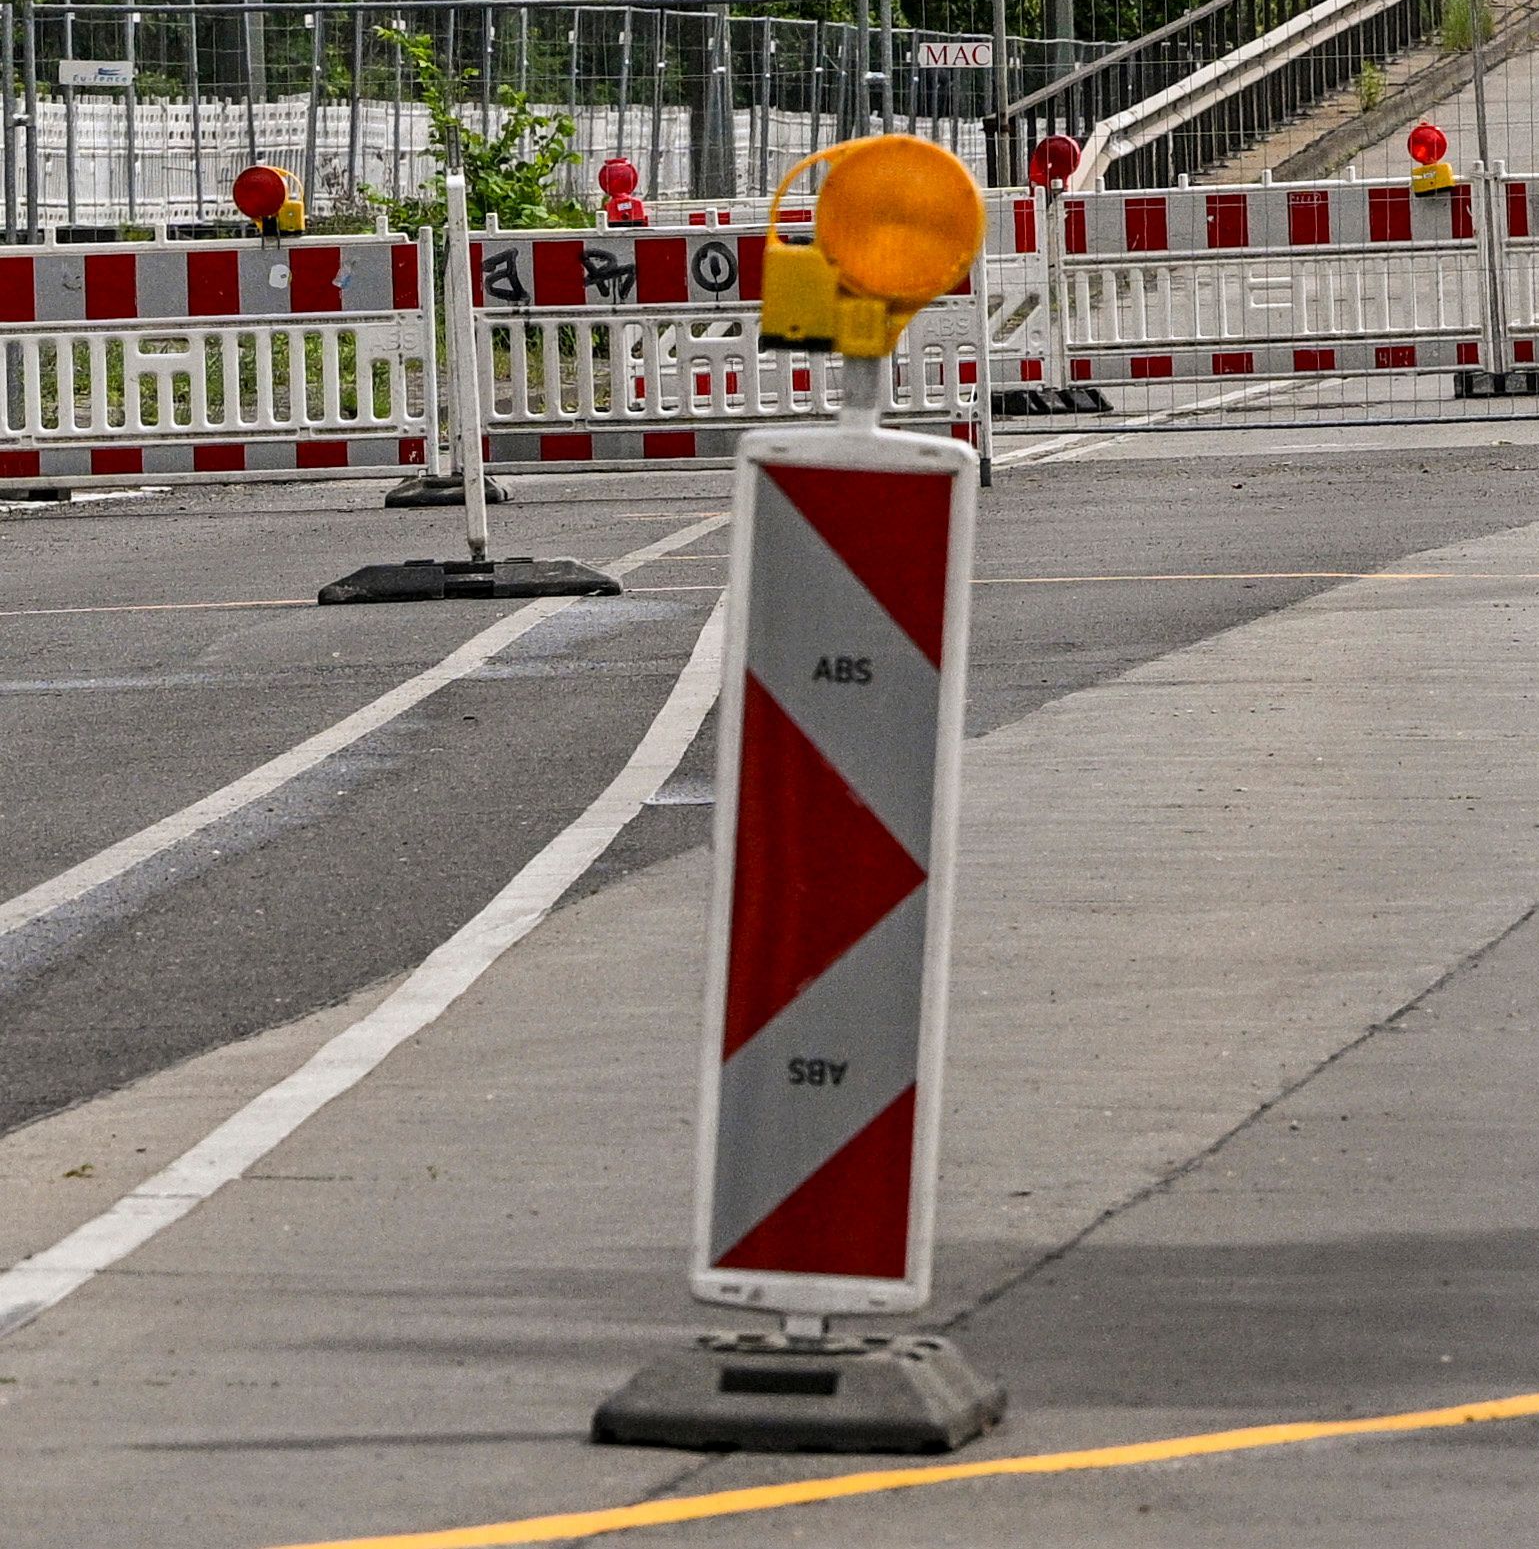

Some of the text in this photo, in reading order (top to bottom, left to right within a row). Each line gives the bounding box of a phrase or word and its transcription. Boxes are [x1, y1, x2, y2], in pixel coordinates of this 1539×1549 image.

[925, 44, 991, 66] MAC
[811, 656, 873, 686] ABS
[788, 1056, 849, 1087] ABS
